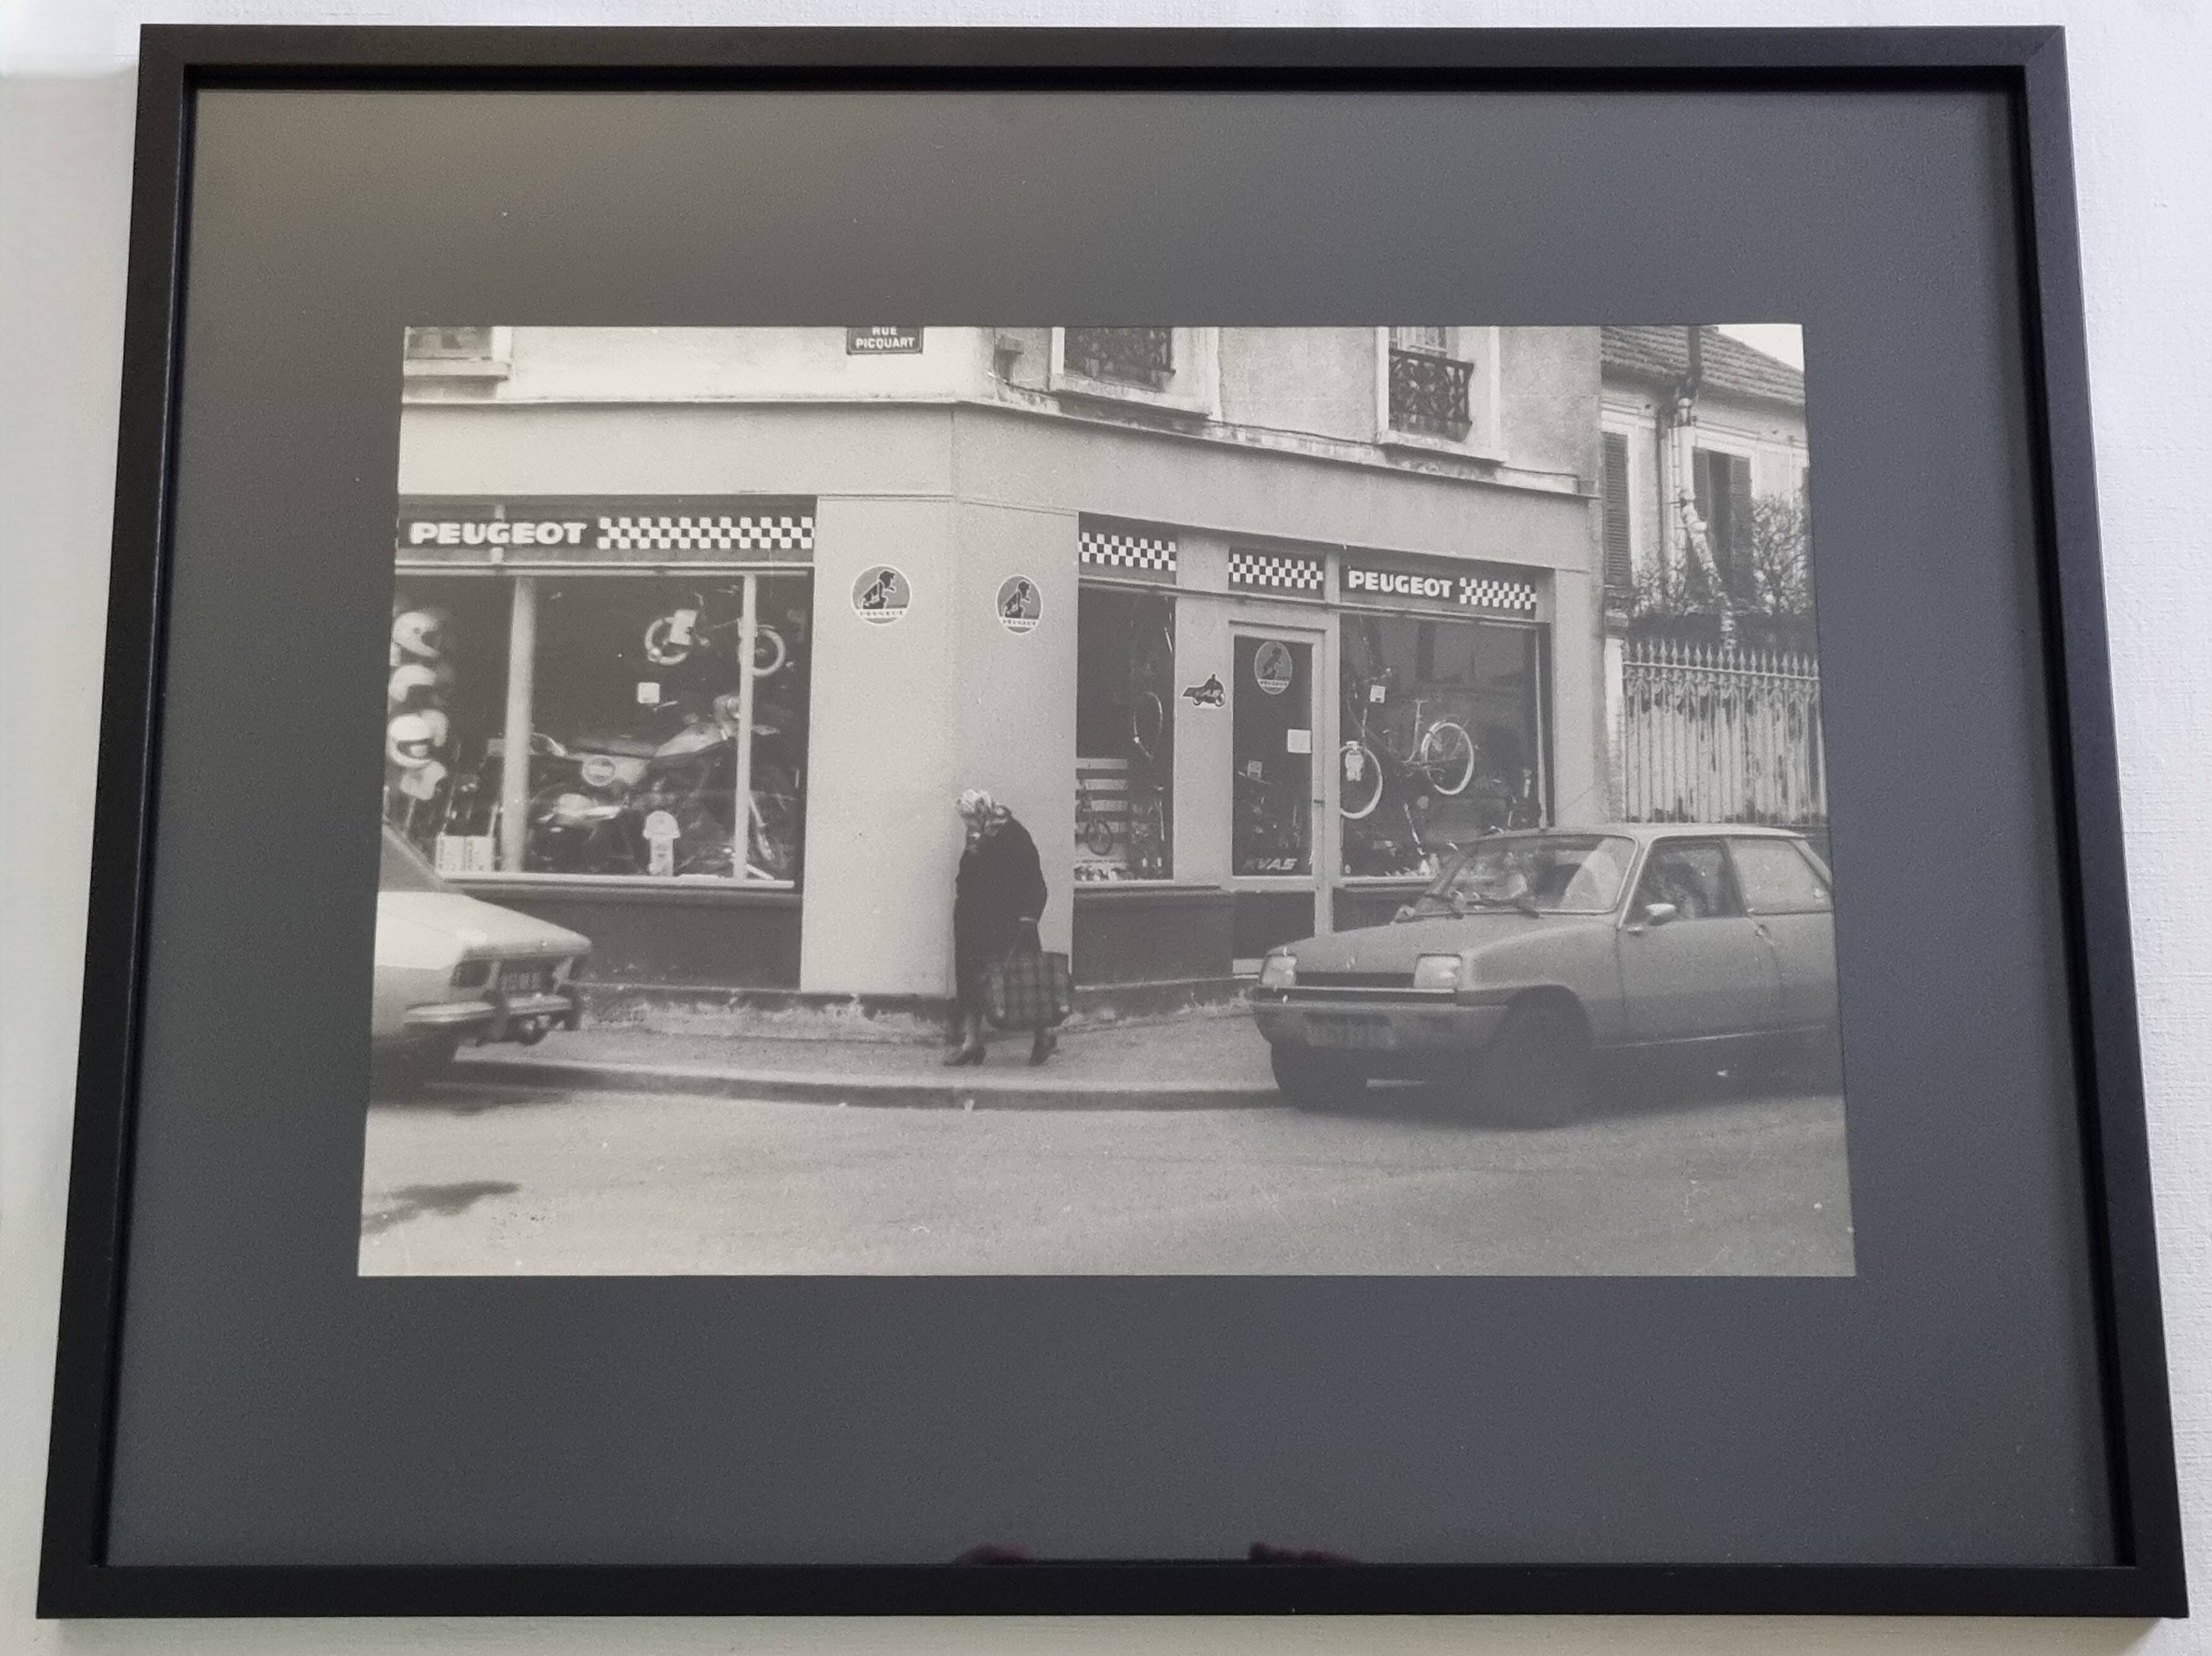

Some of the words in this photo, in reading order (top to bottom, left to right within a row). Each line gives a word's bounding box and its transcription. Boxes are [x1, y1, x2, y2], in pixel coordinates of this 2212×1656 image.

[872, 326, 897, 335] RUE
[855, 337, 916, 349] PICQUART
[410, 522, 587, 545] PEUGEOT
[1348, 570, 1453, 598] PEUGEOT
